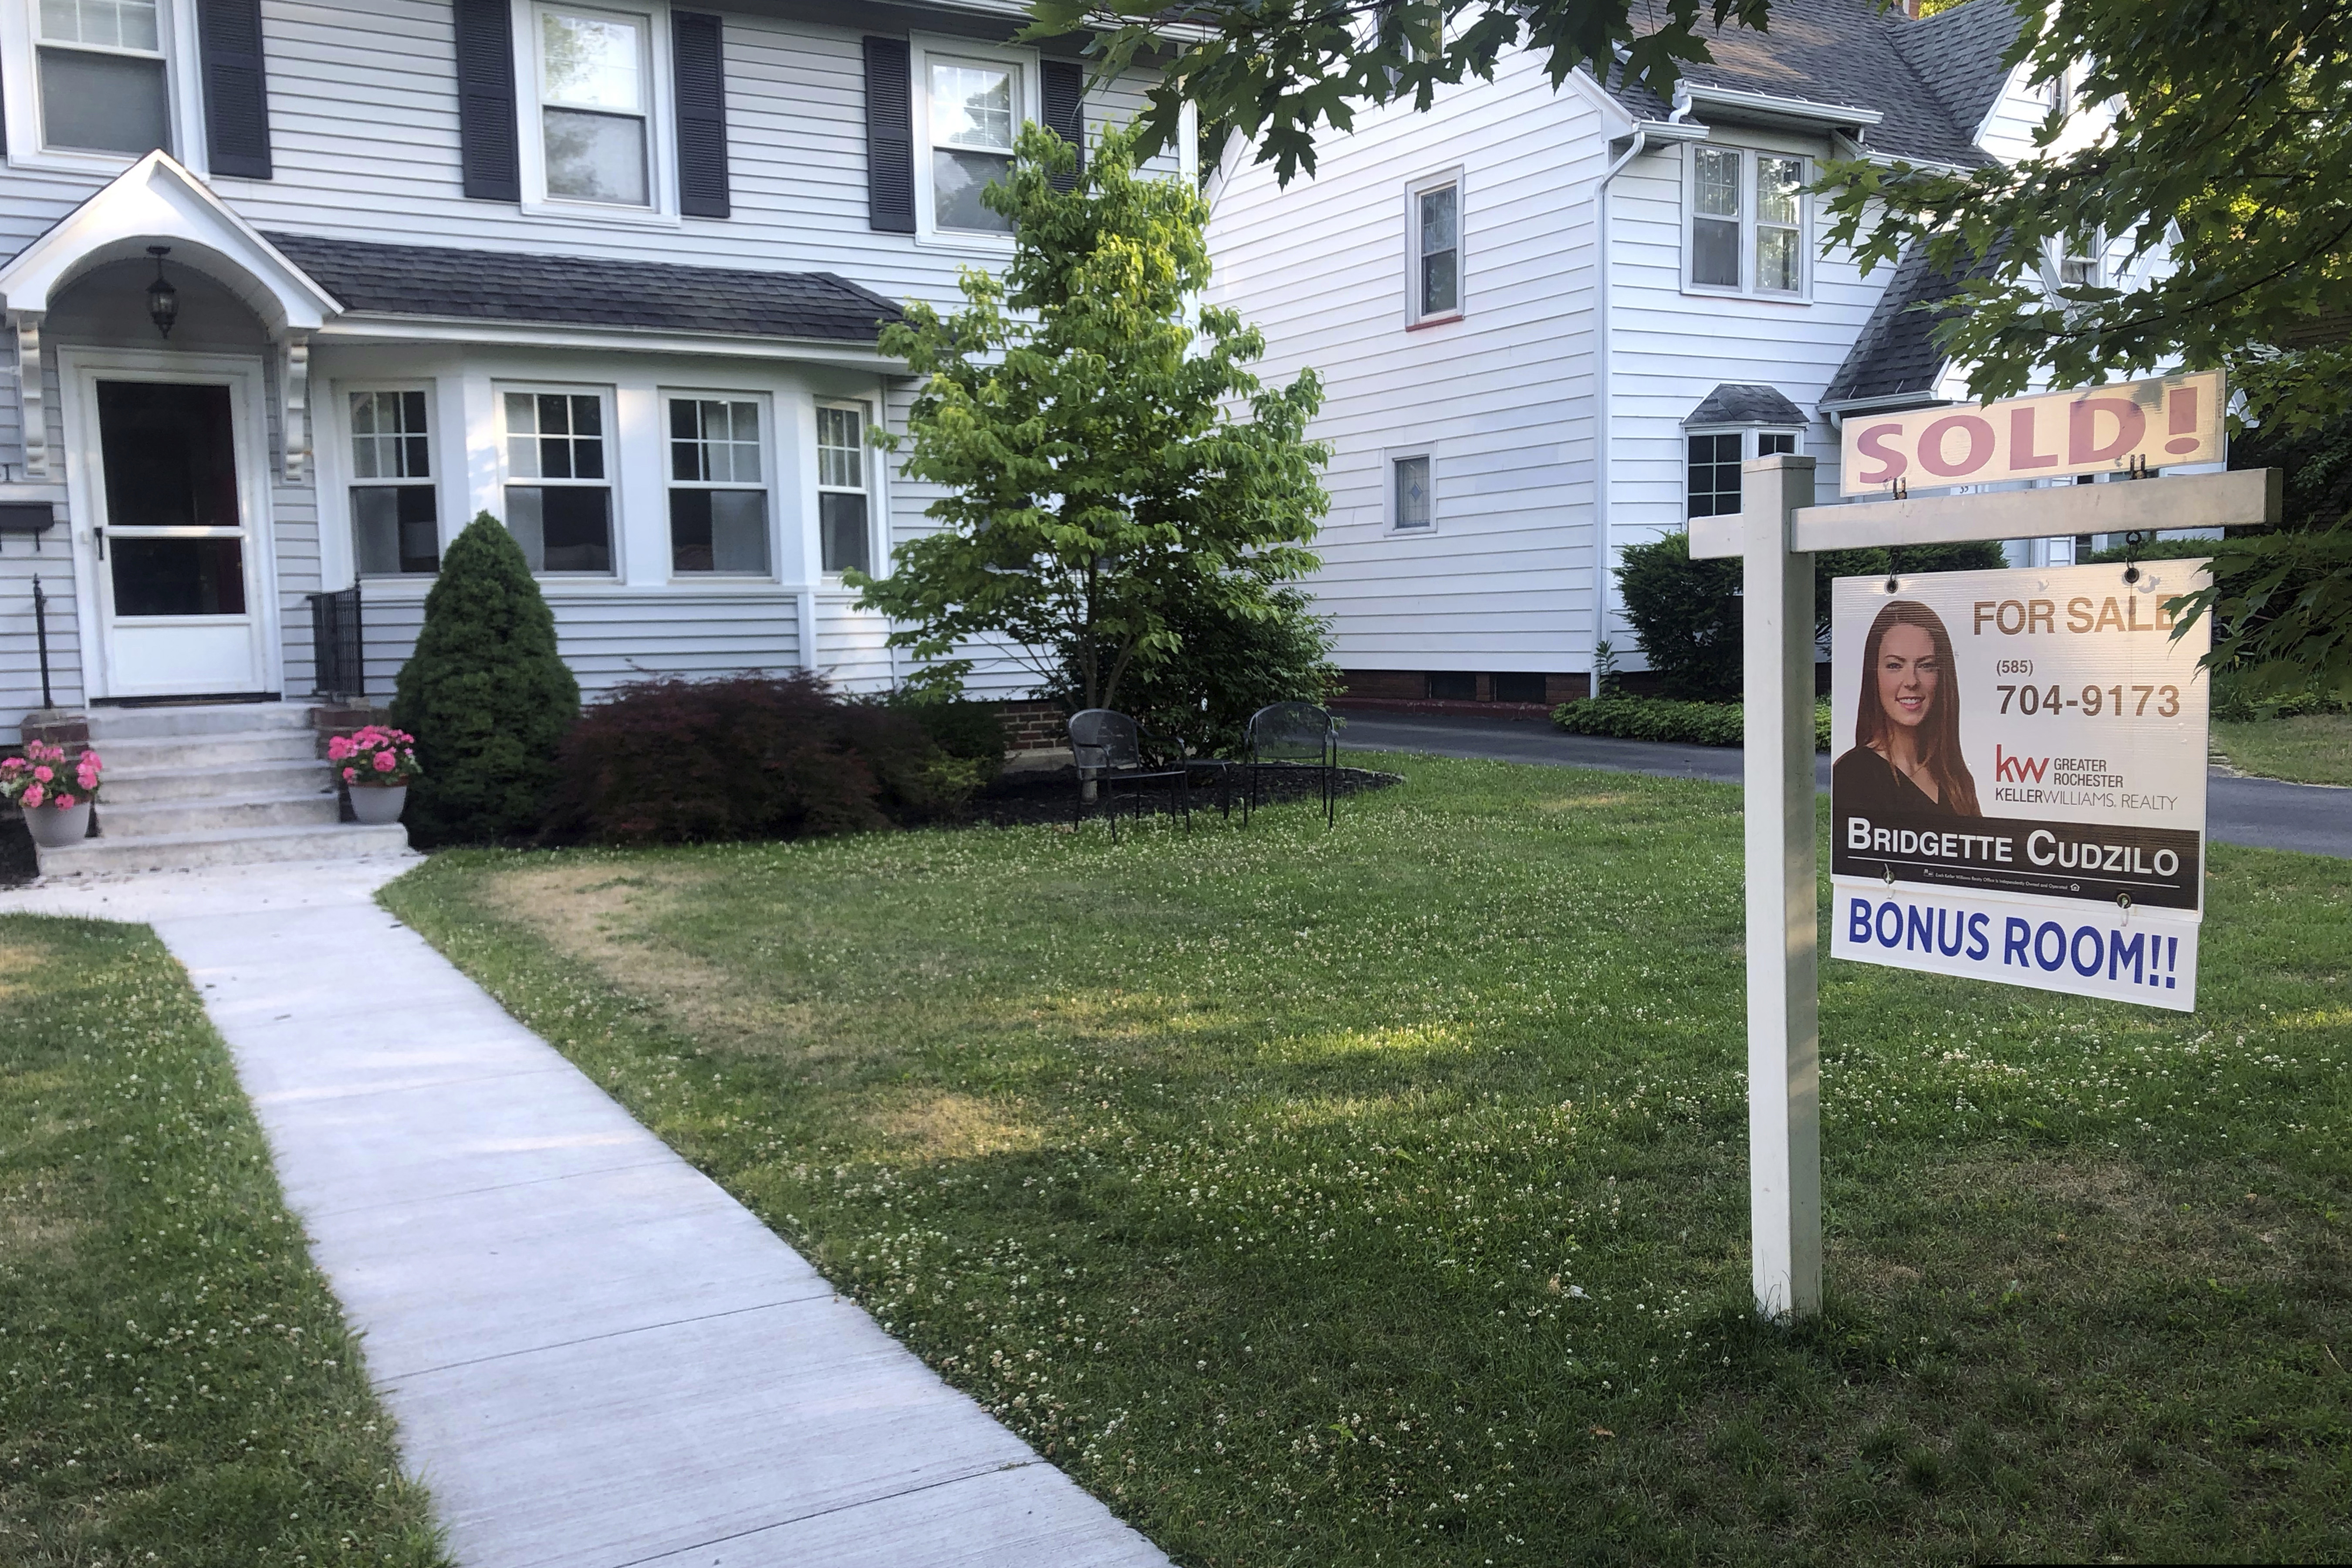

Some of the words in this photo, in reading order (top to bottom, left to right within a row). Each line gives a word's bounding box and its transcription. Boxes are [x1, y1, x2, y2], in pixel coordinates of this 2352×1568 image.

[1857, 386, 2200, 484] SOLD!
[1974, 599, 2055, 635] FOR
[2067, 594, 2183, 634] SALE
[1996, 659, 2034, 677] (585)
[1996, 685, 2180, 717] 704-9173
[1995, 744, 2050, 784] kw
[2054, 758, 2107, 772] GREATER
[2054, 773, 2124, 788] ROCHESTER
[2122, 795, 2178, 811] REALTY
[1848, 817, 2013, 862] BRIDGETTE
[2027, 829, 2179, 876] CUDZILO
[1849, 898, 1990, 961] BONUS
[2004, 917, 2179, 989] ROOM!!
